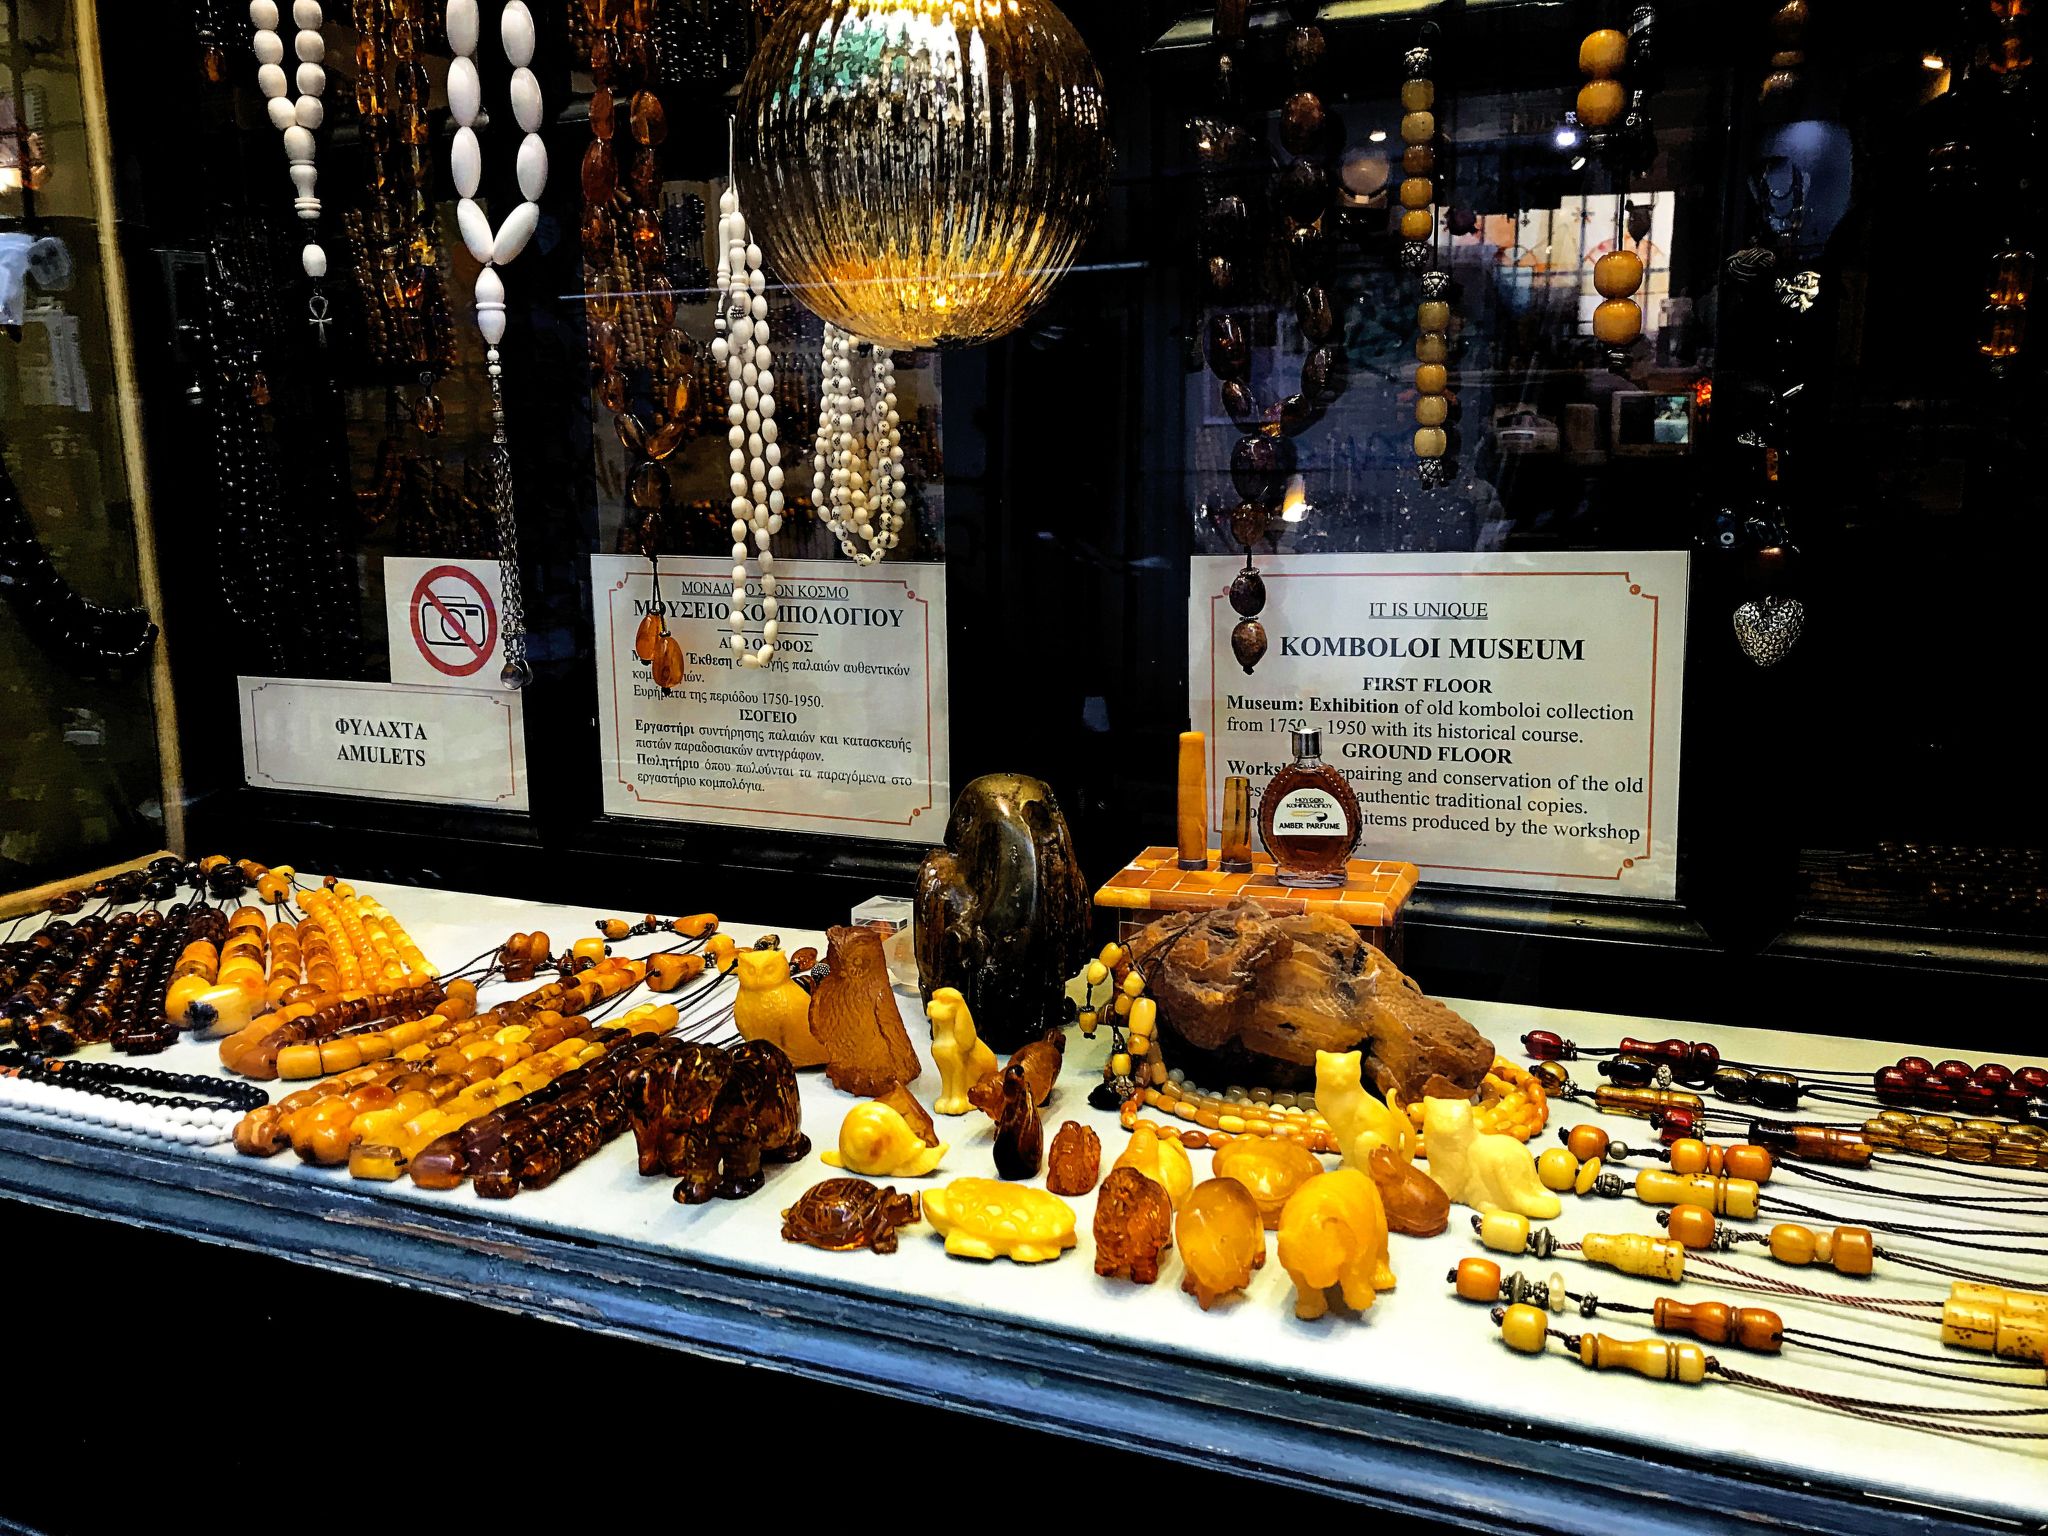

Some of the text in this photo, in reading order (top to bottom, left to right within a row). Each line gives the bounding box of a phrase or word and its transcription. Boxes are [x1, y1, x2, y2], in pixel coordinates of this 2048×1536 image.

[682, 581, 849, 599] ΜΟΝΑΔΙΟ ΣΟΝ ΚΟΣΜΟ
[634, 599, 730, 620] ΜΟΥΣΕΙΟ
[1369, 602, 1488, 620] IT IS UNIQUE
[752, 638, 813, 653] ΟΟΦΟΣ
[1279, 636, 1585, 661] KOMBOLOI MUSEUM
[686, 652, 732, 669] Έκθεση
[792, 659, 840, 673] παλαιών
[843, 661, 910, 676] αυθεντικών
[1362, 677, 1492, 694] FIRST FLOOR
[689, 690, 707, 703] της
[710, 691, 758, 704] περιόδου
[762, 693, 824, 708] 1750-1950.
[1226, 695, 1634, 721] Museum: Exhibition of old komboloi collection
[739, 709, 797, 724] ΙΣΟΓΕΙΟ
[335, 718, 427, 740] ΦΥΛΑΧΤΑ
[635, 719, 912, 753] Εργαστήρι συντήρησης παλαιών και κατασκευής
[1227, 716, 1263, 731] from
[1328, 720, 1366, 735] 1950
[1371, 720, 1407, 737] with
[1413, 722, 1432, 738] its
[1438, 723, 1515, 741] historical
[1521, 727, 1583, 743] course.
[337, 744, 425, 767] AMULETS
[635, 738, 824, 763] πιστών παραδοσιακών αντιγράφων.
[1342, 743, 1512, 764] GROUND FLOOR
[637, 753, 912, 786] Πωλητήριο όπου πωλούνται τα παραγόμενα στο
[1337, 766, 1402, 785] epairing
[1407, 768, 1437, 783] and
[1443, 771, 1551, 789] conservation
[1557, 774, 1579, 790] of
[1582, 775, 1609, 791] the
[1614, 777, 1643, 793] old
[637, 772, 765, 793] εργαστήριο κομπολόγια.
[1356, 788, 1588, 816] authentic traditional copies.
[1279, 822, 1341, 830] AMBER PARFUME
[1364, 810, 1640, 844] items produced by the workshop
